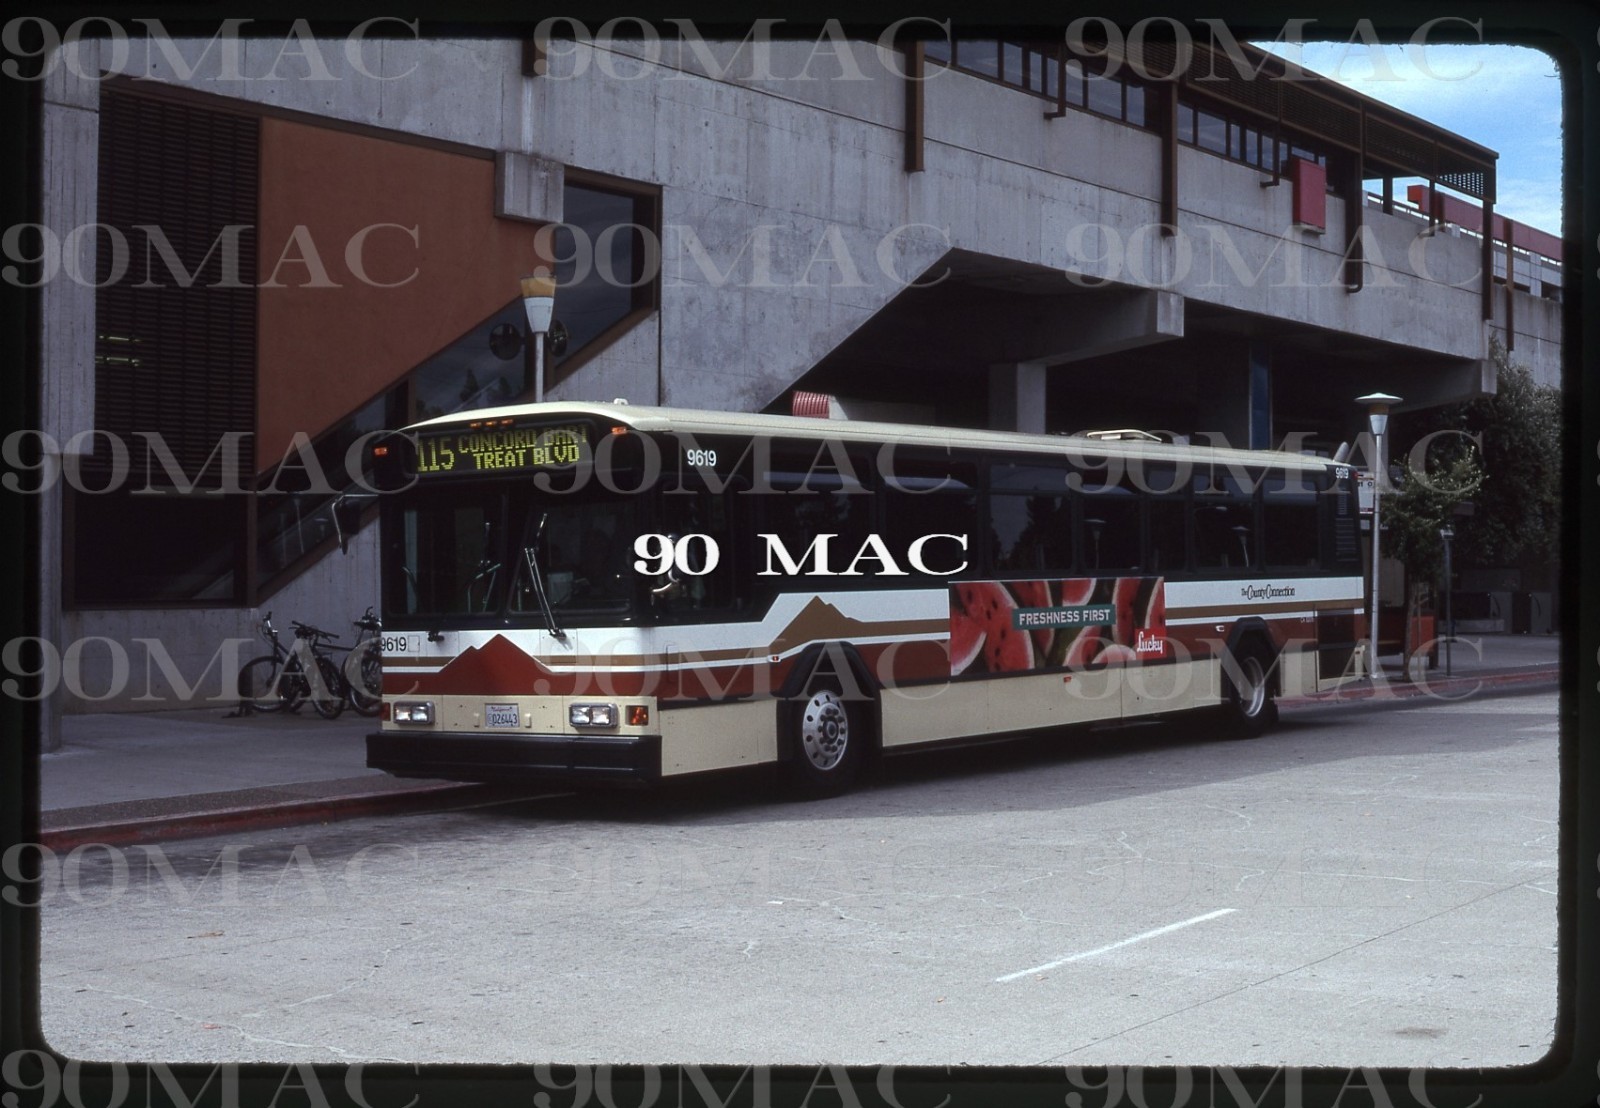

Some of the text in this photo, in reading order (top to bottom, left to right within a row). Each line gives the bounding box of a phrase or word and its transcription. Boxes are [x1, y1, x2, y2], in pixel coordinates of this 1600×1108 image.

[458, 428, 537, 453] CONCORD
[417, 437, 455, 472] 115
[473, 445, 580, 470] TREAT BLVD
[687, 449, 717, 467] 9619
[1018, 609, 1111, 626] FRESHNESS FIRST
[381, 636, 407, 651] 9619
[1136, 630, 1164, 654] Lucky
